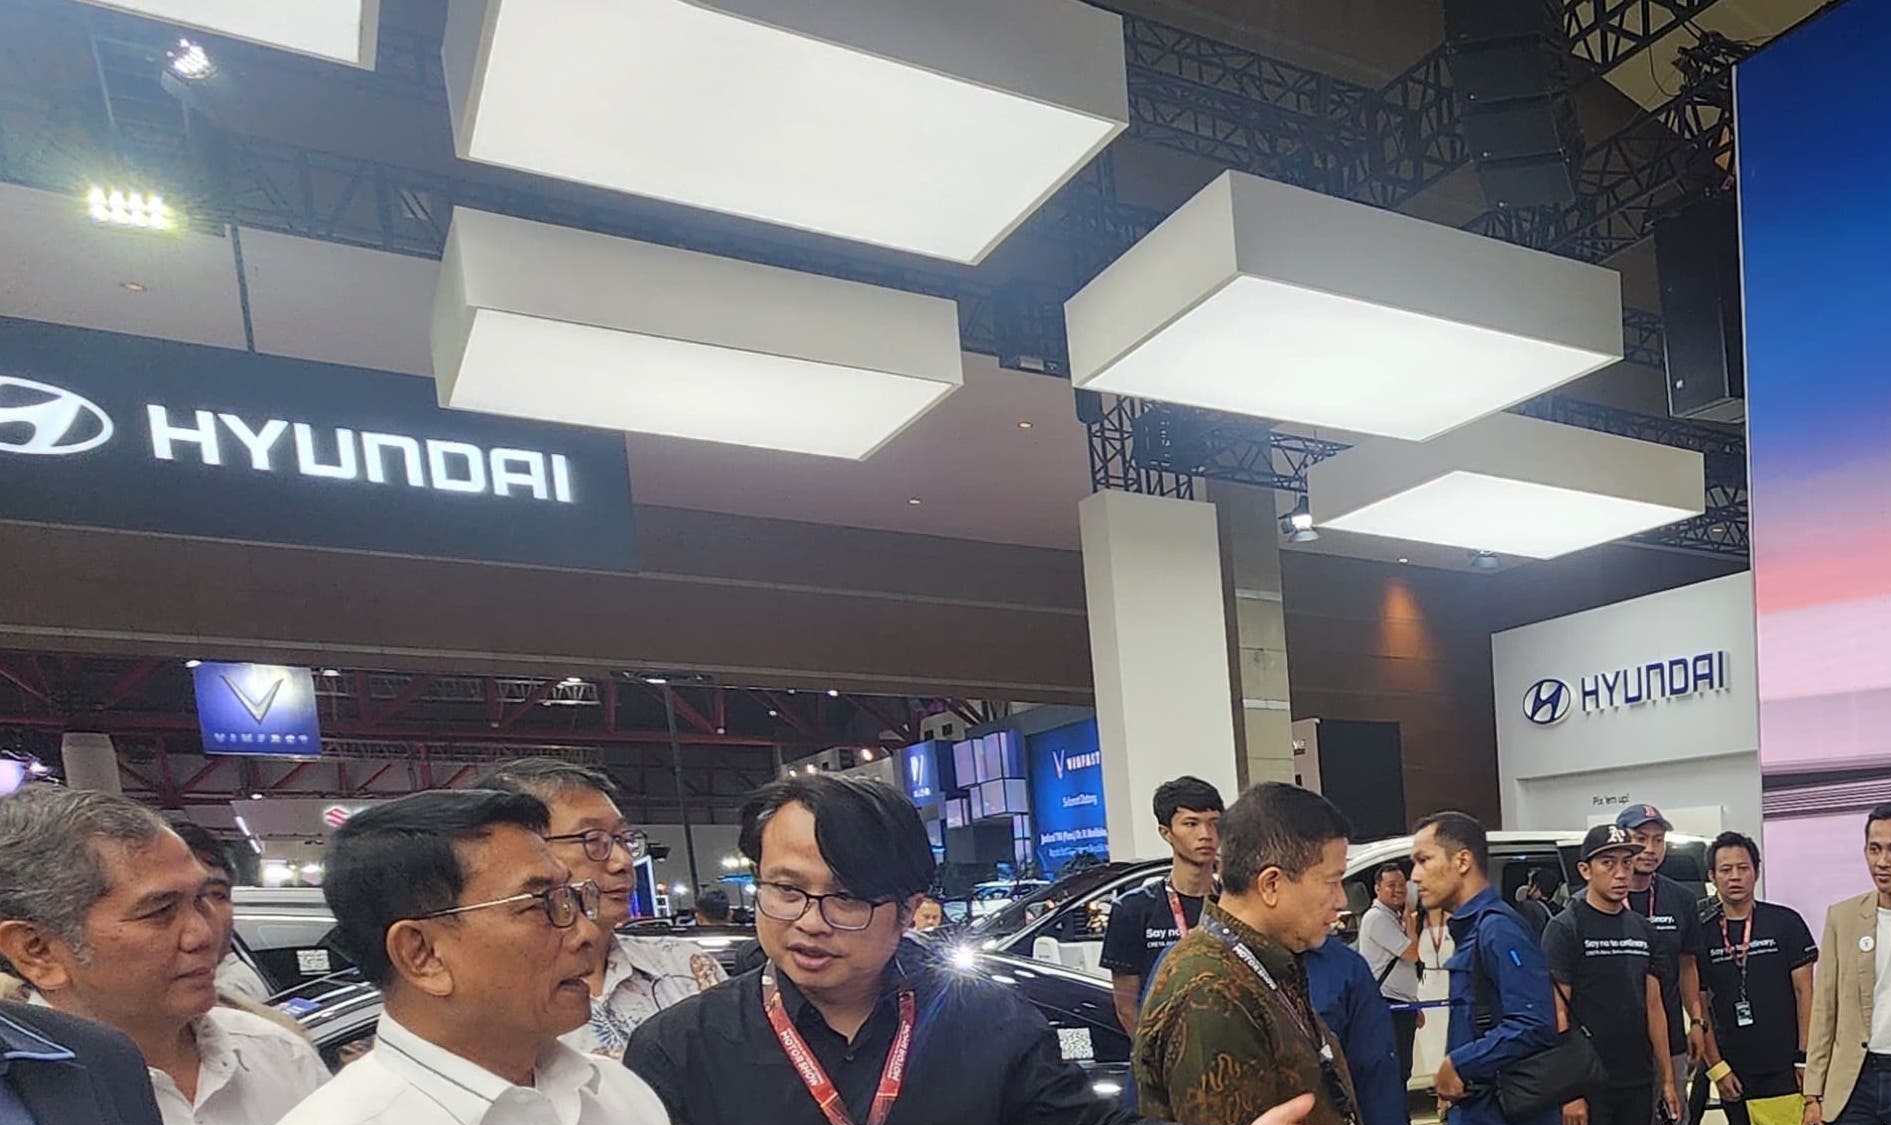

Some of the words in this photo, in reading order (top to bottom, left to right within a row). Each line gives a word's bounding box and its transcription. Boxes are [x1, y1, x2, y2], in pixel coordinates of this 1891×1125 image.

[147, 403, 572, 503] HYUNDAI
[1581, 651, 1726, 714] HYUNDAI
[1145, 928, 1166, 940] Say
[780, 1030, 804, 1063] MOTOR
